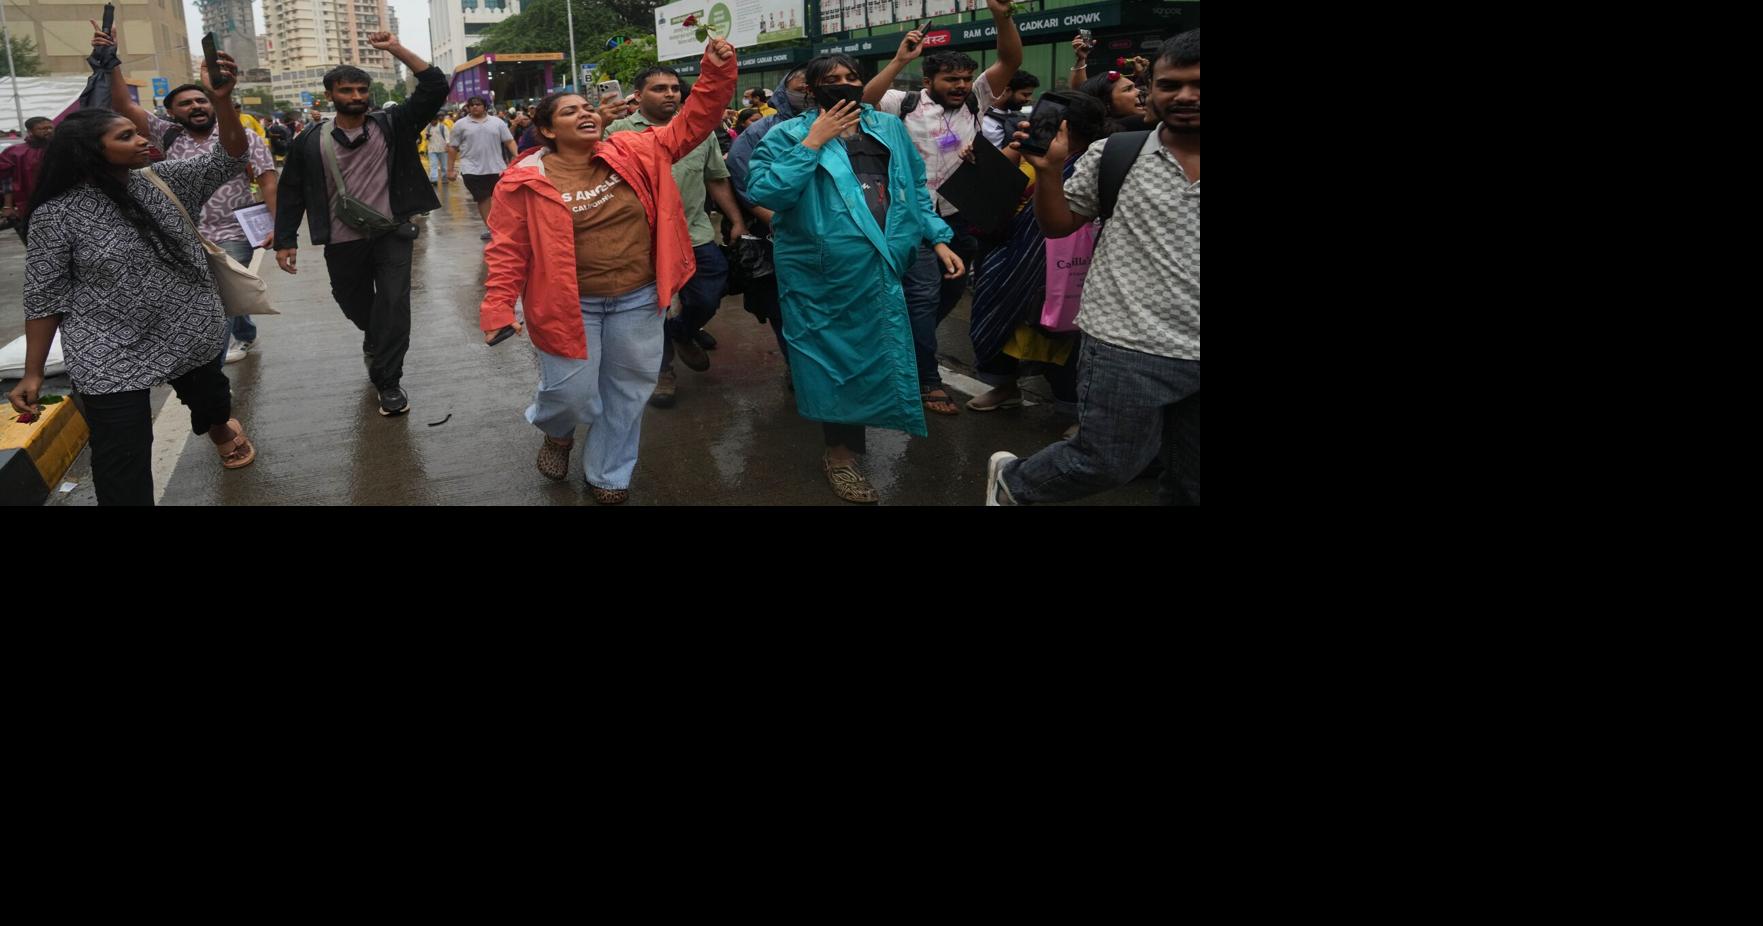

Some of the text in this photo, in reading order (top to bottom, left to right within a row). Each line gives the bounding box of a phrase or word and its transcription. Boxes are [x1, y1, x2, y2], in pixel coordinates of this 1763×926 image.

[963, 29, 982, 38] RAM
[1019, 18, 1058, 31] GADKARI
[1064, 12, 1100, 26] CHOWK
[575, 173, 622, 201] ANGELE
